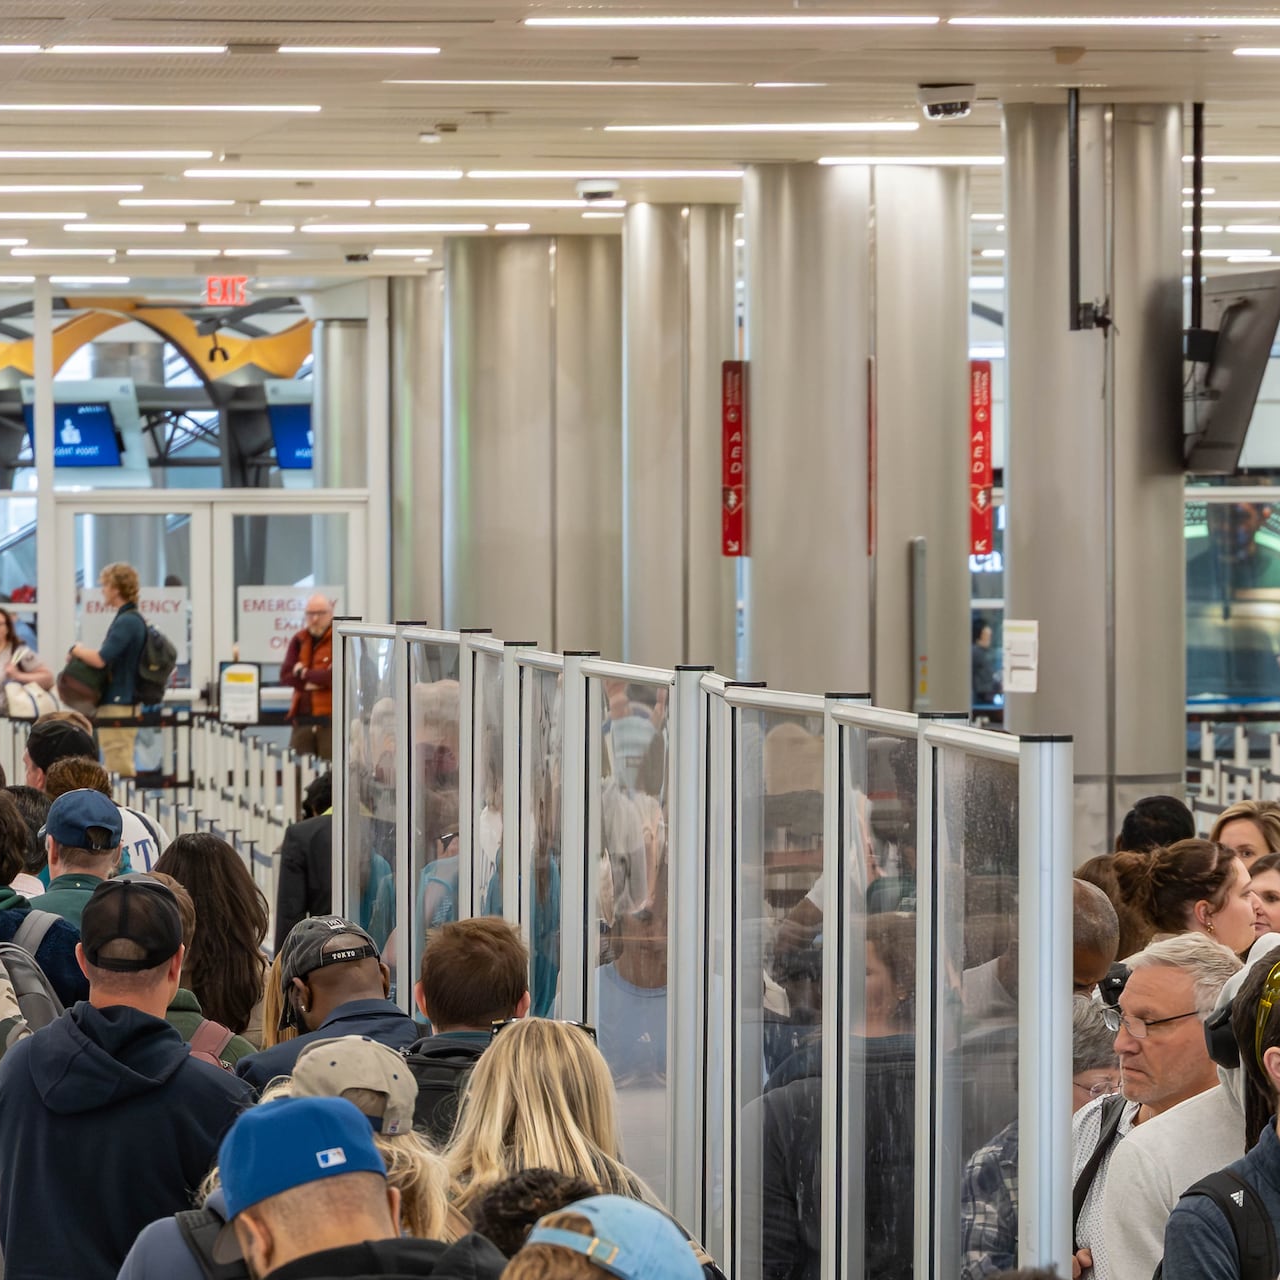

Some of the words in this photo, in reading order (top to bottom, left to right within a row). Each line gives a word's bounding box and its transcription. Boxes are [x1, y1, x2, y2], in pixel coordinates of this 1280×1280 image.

[207, 276, 248, 306] EXIT
[730, 432, 741, 474] AED
[972, 431, 984, 473] AED
[86, 600, 181, 614] EMENCY
[332, 950, 356, 960] TOKYO
